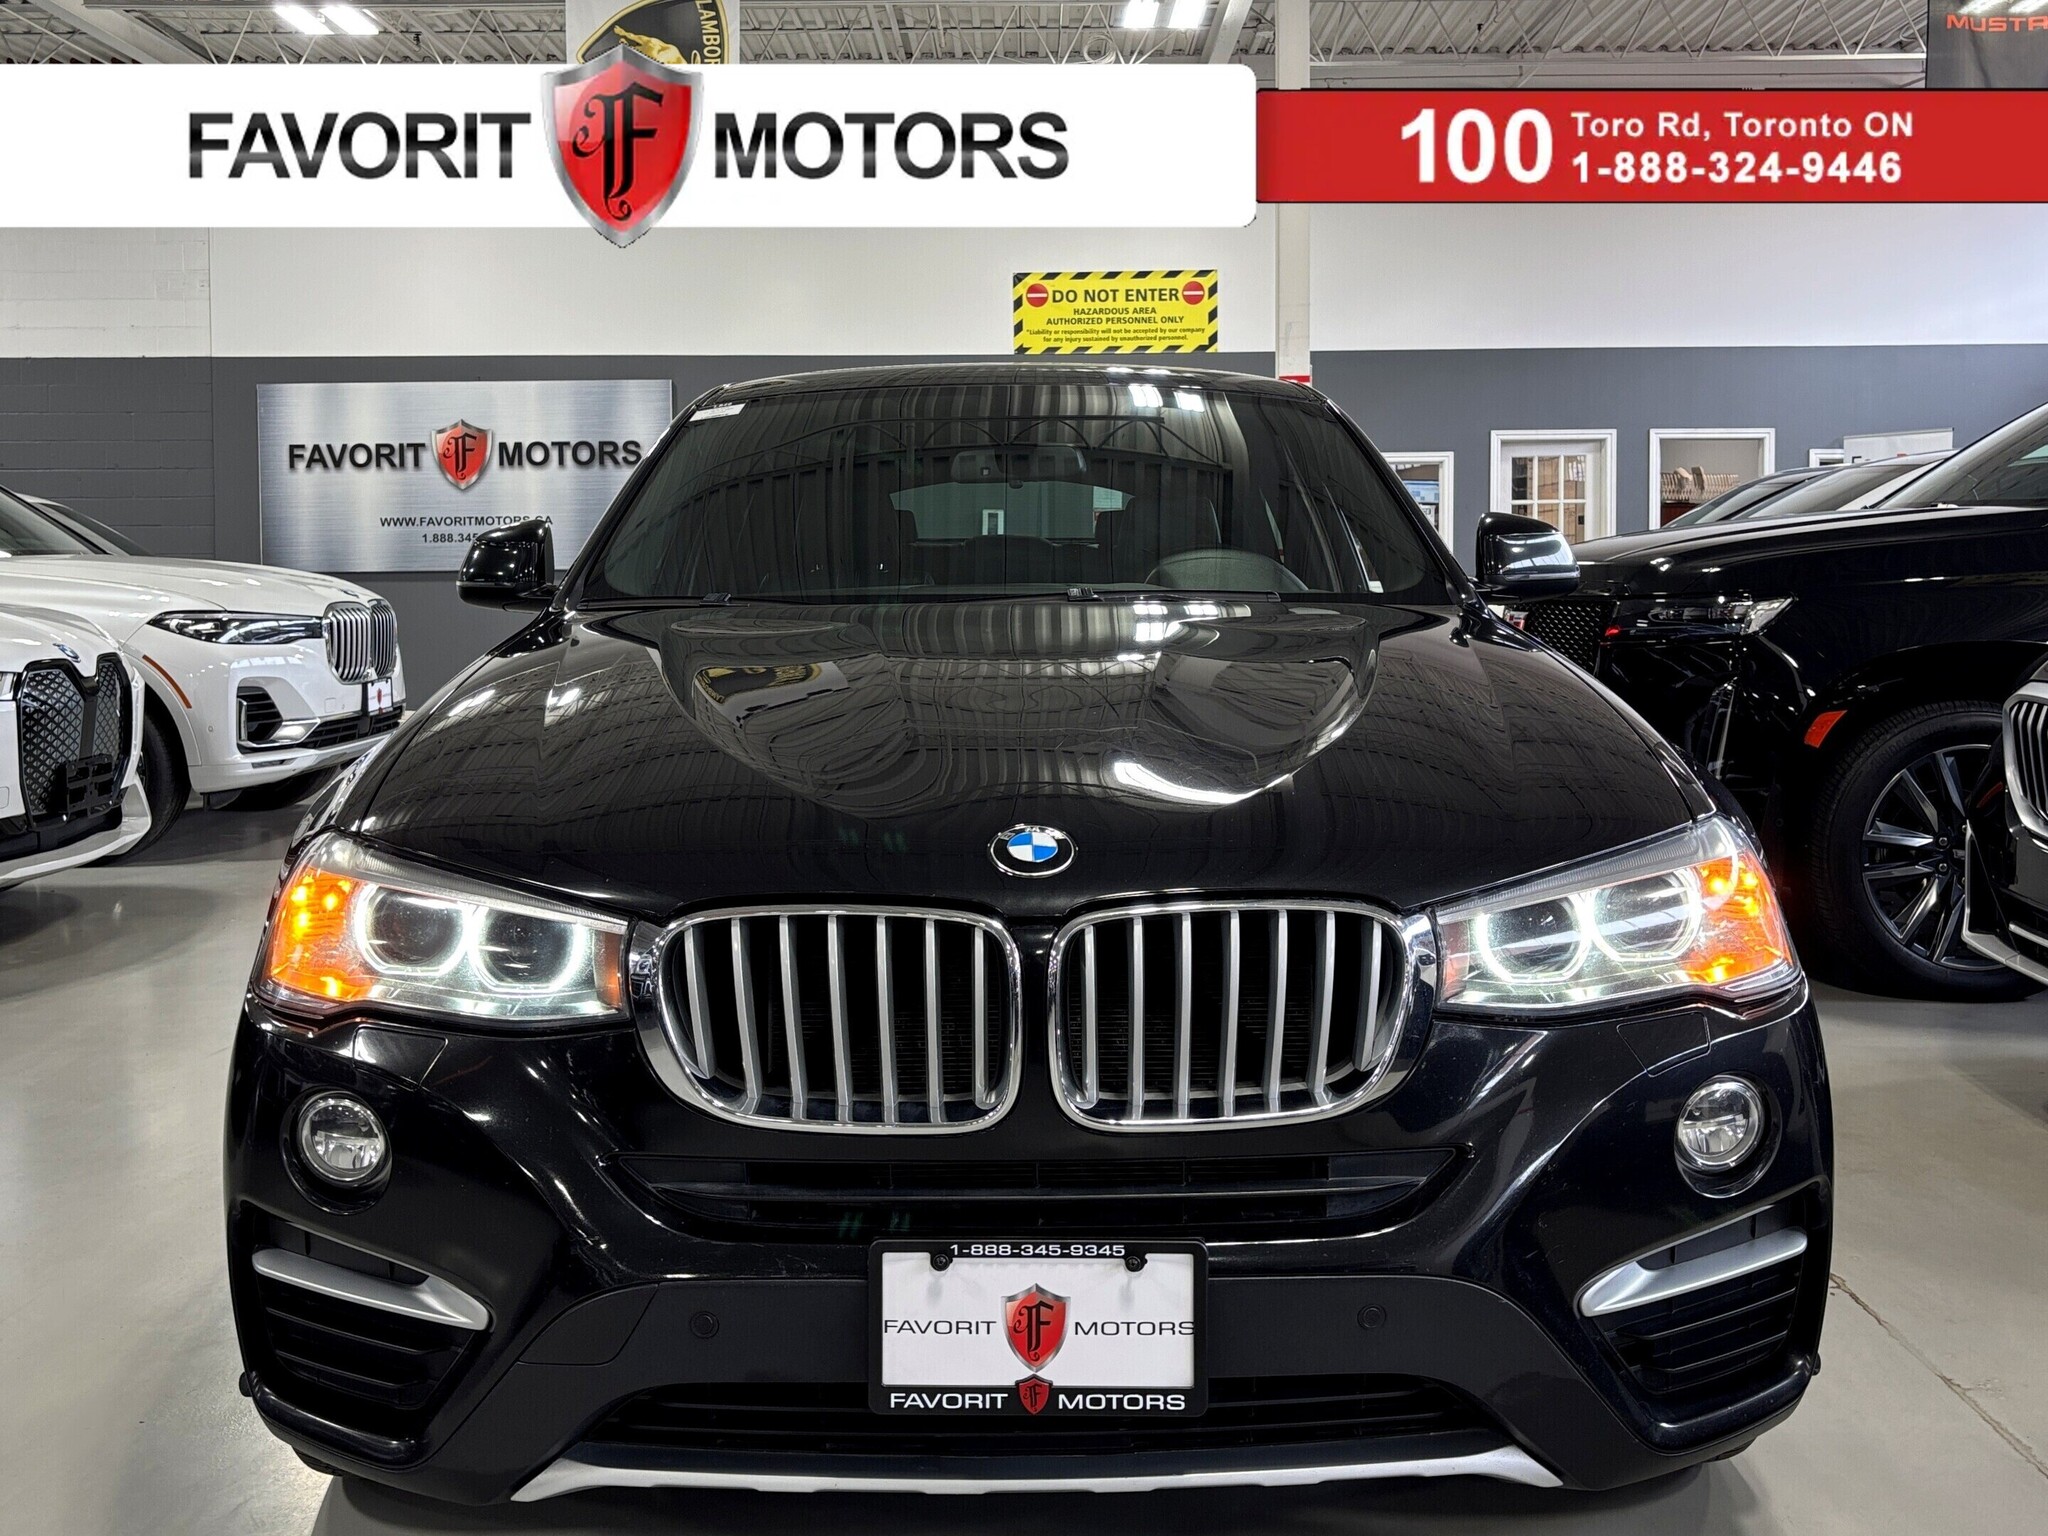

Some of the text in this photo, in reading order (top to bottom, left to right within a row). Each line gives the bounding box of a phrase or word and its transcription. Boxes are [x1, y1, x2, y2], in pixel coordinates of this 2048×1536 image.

[1052, 288, 1180, 304] DO NOT ENTER
[1073, 307, 1157, 316] HAZARDOUS AREA
[1046, 315, 1184, 326] AUTHORIZED PERSONNEL ONLY
[1061, 328, 1100, 336] responsibility
[1133, 327, 1158, 335] accepted
[1159, 327, 1166, 335] by
[1065, 336, 1081, 344] injury
[1111, 335, 1118, 343] by
[289, 443, 426, 469] FAVORIT
[499, 440, 642, 467] MOTORS
[950, 1244, 1125, 1257] 1-888-345-9345
[884, 1320, 997, 1335] FAVORIT
[1074, 1321, 1195, 1336] MOTORS
[890, 1393, 1008, 1409] FAVORIT
[1058, 1394, 1185, 1410] MOTORS
